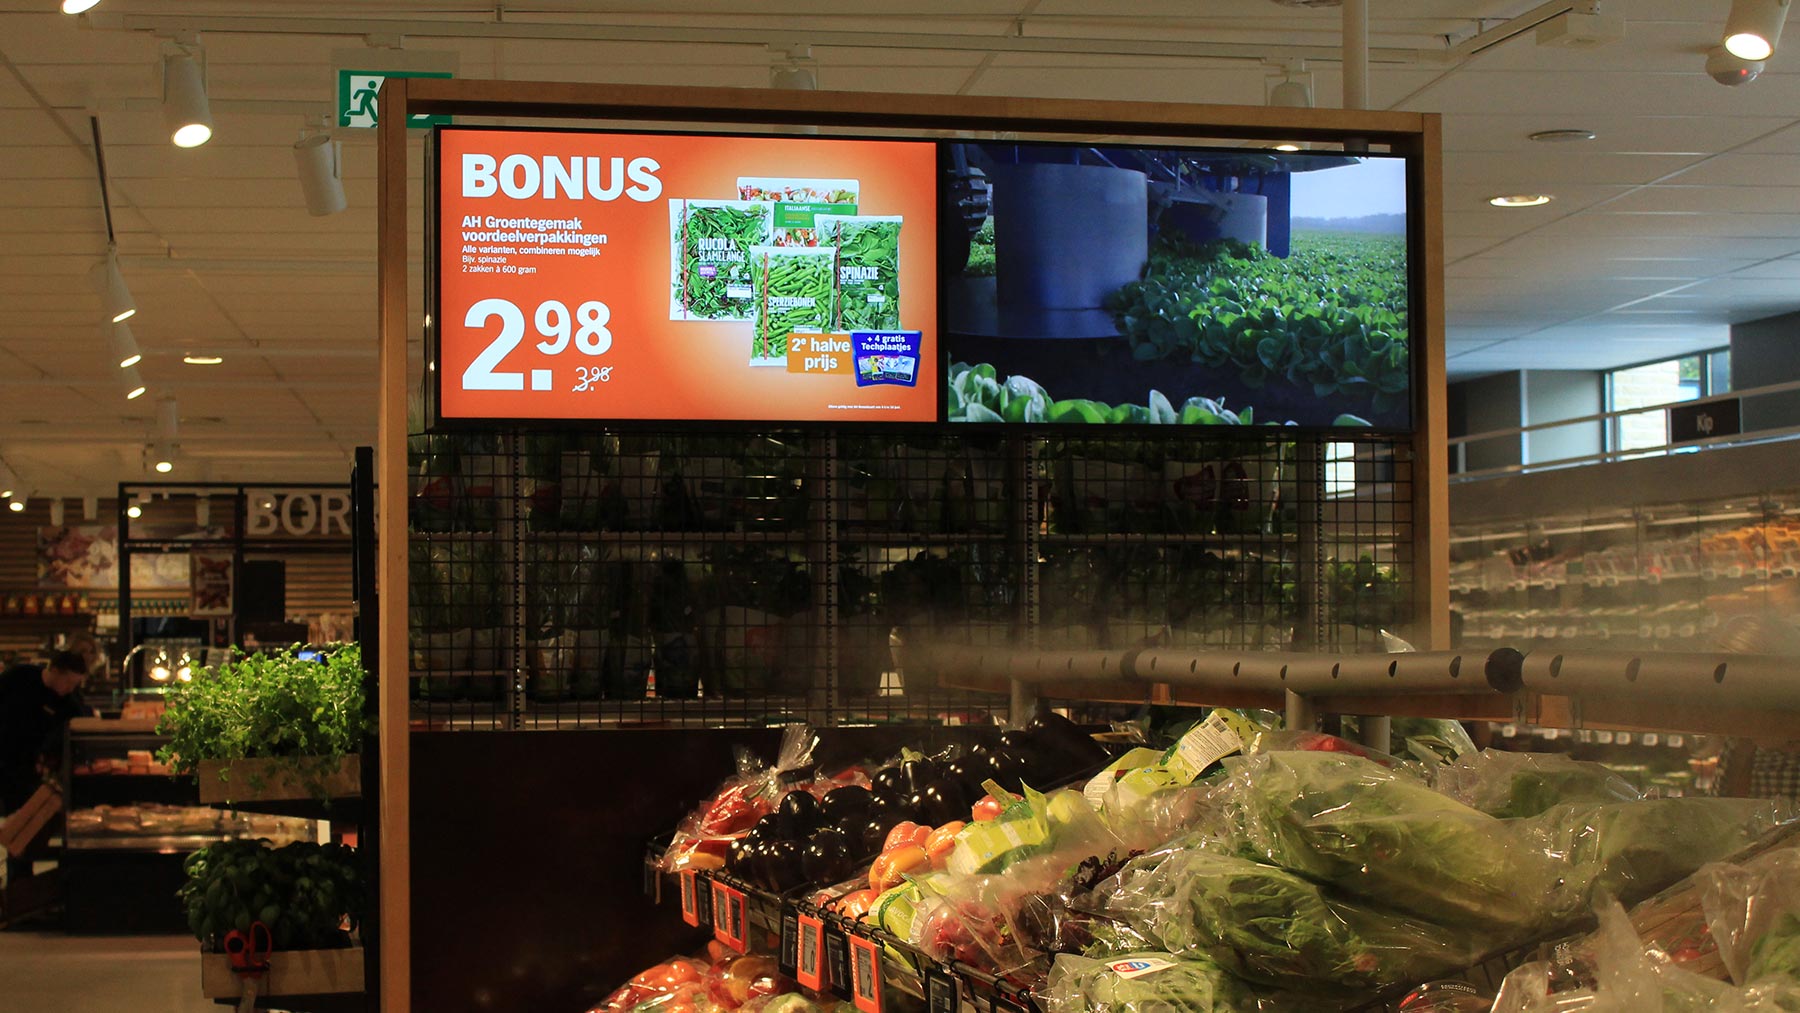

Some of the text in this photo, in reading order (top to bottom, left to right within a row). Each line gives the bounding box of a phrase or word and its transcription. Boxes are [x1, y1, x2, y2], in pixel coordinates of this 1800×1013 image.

[462, 153, 663, 202] BONUS
[462, 216, 583, 232] AH Groentegemak
[462, 229, 608, 246] voordeelverpakkingen
[698, 237, 736, 251] RUCOLA
[462, 245, 601, 257] Alle varianten, combineren mogelijk
[698, 251, 746, 262] SLAMELANGE
[478, 256, 507, 265] spinazie
[462, 265, 468, 273] 2
[469, 265, 494, 273] zakken
[518, 267, 537, 275] gram
[840, 266, 879, 280] SPINAZIE
[767, 296, 816, 307] SPERZIEBONEN
[462, 298, 613, 391] 2.98
[810, 337, 851, 353] halve
[874, 335, 880, 343] 4
[882, 335, 906, 344] gratis
[861, 342, 912, 352] Techplaatjes
[804, 354, 838, 372] prijs
[1696, 412, 1714, 435] Kip
[246, 491, 376, 536] BOR
